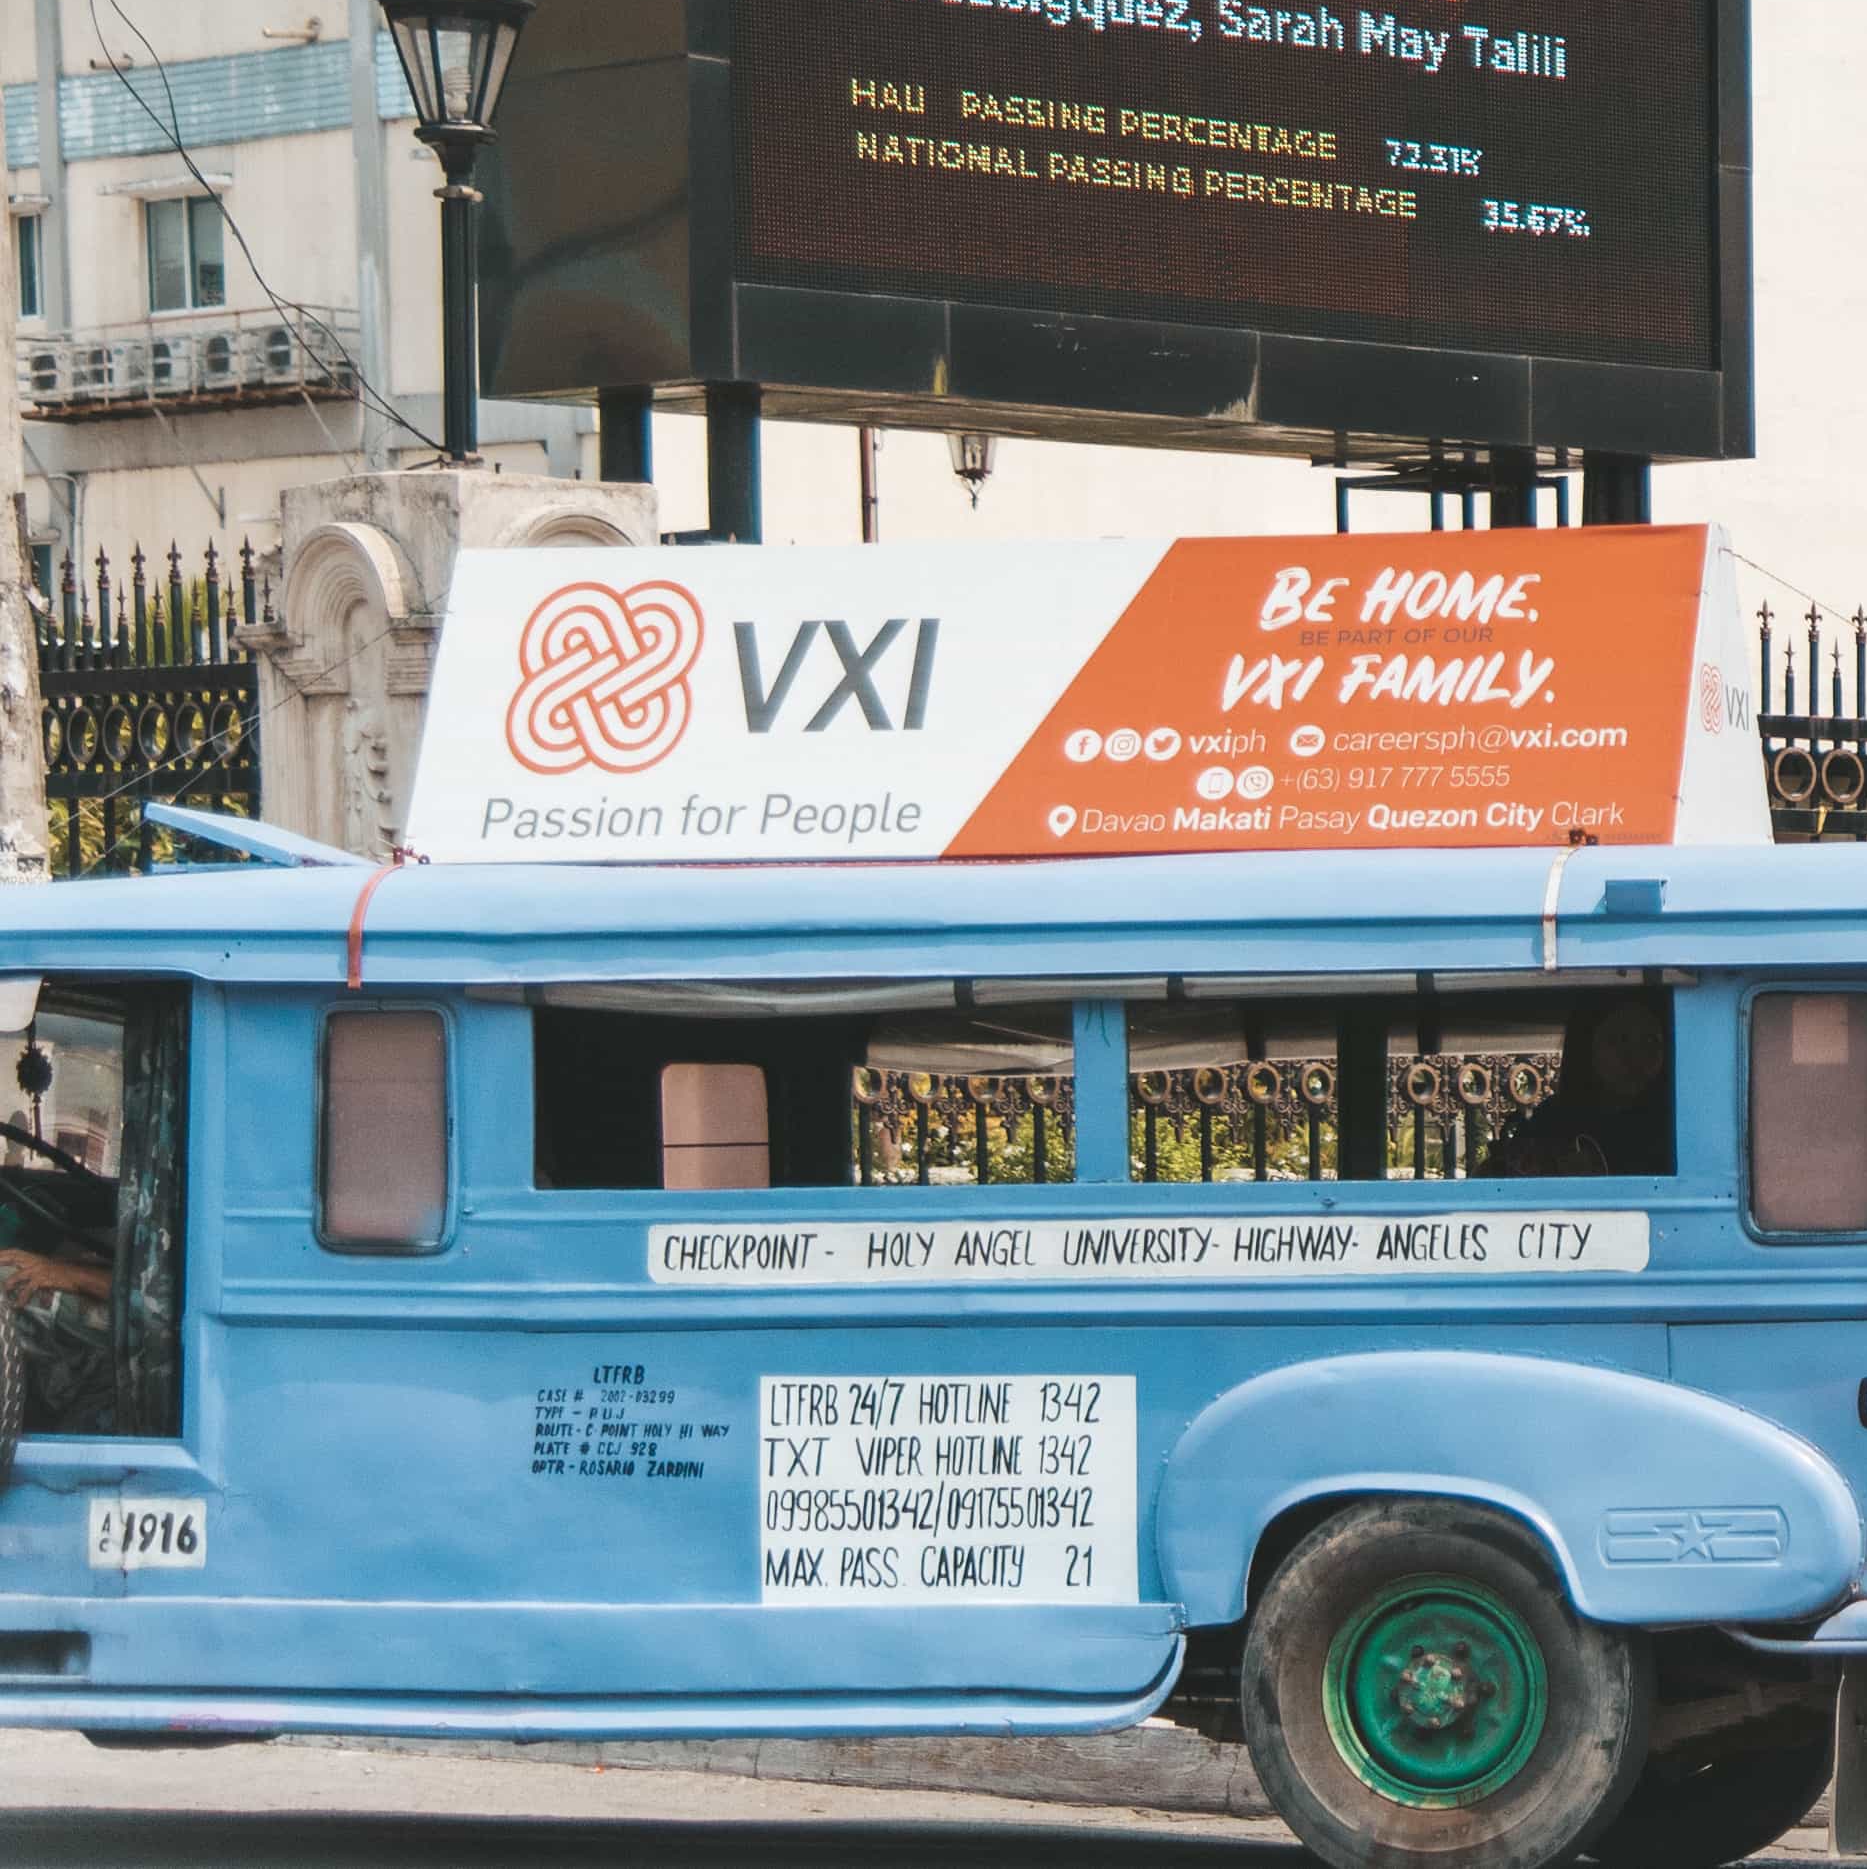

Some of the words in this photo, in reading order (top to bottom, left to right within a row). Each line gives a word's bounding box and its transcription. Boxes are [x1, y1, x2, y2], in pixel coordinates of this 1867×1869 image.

[1359, 11, 1450, 72] May
[1463, 26, 1567, 80] Talili
[851, 78, 926, 115] HAU
[961, 89, 1106, 137] PASSING
[1119, 109, 1338, 161] PERCENTAGE
[856, 131, 1040, 179] NATIONAL
[1049, 151, 1195, 200] PASSING
[1204, 169, 1418, 219] PERCENTAGE
[1359, 566, 1541, 625] HOME.
[1300, 631, 1329, 647] BE
[1337, 629, 1396, 646] PART
[1404, 628, 1436, 645] OF
[1443, 626, 1494, 644] OUR
[732, 618, 941, 733] VXI
[1221, 653, 1325, 711] VXI
[1338, 649, 1555, 709] FAMILY.
[1725, 683, 1749, 732] VXI
[1188, 727, 1267, 757] vxiph
[1332, 722, 1628, 755] careersph@vxi.com
[1279, 768, 1342, 794] +(63)
[1348, 767, 1394, 789] 917
[1400, 766, 1444, 788] 777
[1449, 764, 1512, 787] 5555
[480, 795, 664, 840] Passion
[680, 793, 747, 838] for
[758, 790, 922, 844] People
[1081, 808, 1166, 832] Davao
[1172, 804, 1272, 832] Makati
[1278, 804, 1361, 834] Pasay
[1367, 803, 1478, 832] Quezon
[1485, 802, 1545, 831] City
[1550, 800, 1626, 827] Clark
[867, 1231, 935, 1269] HOLY
[954, 1230, 1035, 1266] ANGEL
[1376, 1223, 1489, 1262] ANGELES
[1518, 1222, 1593, 1260] CITY
[537, 1389, 566, 1403] CASE
[593, 1365, 645, 1384] LTFRB
[770, 1382, 839, 1427] LTFRB
[848, 1378, 905, 1430] 24/7
[919, 1380, 1014, 1426] HOTLINE
[1039, 1382, 1102, 1424] 1342
[534, 1441, 570, 1456] PLATE
[597, 1442, 621, 1456] CCJ
[630, 1442, 658, 1457] 928
[643, 1423, 672, 1439] HOLY
[701, 1424, 730, 1438] WAY
[578, 1460, 635, 1476] ROSARIO
[647, 1461, 705, 1479] ZARDINI
[763, 1436, 831, 1477] TXT
[855, 1435, 924, 1477] VIPER
[935, 1434, 1024, 1477] HOTLINE
[1037, 1433, 1094, 1476] 1342
[119, 1511, 199, 1555] 1916
[765, 1547, 830, 1588] MAX.
[920, 1544, 1026, 1588] CAPACITY
[1064, 1544, 1094, 1587] 21
